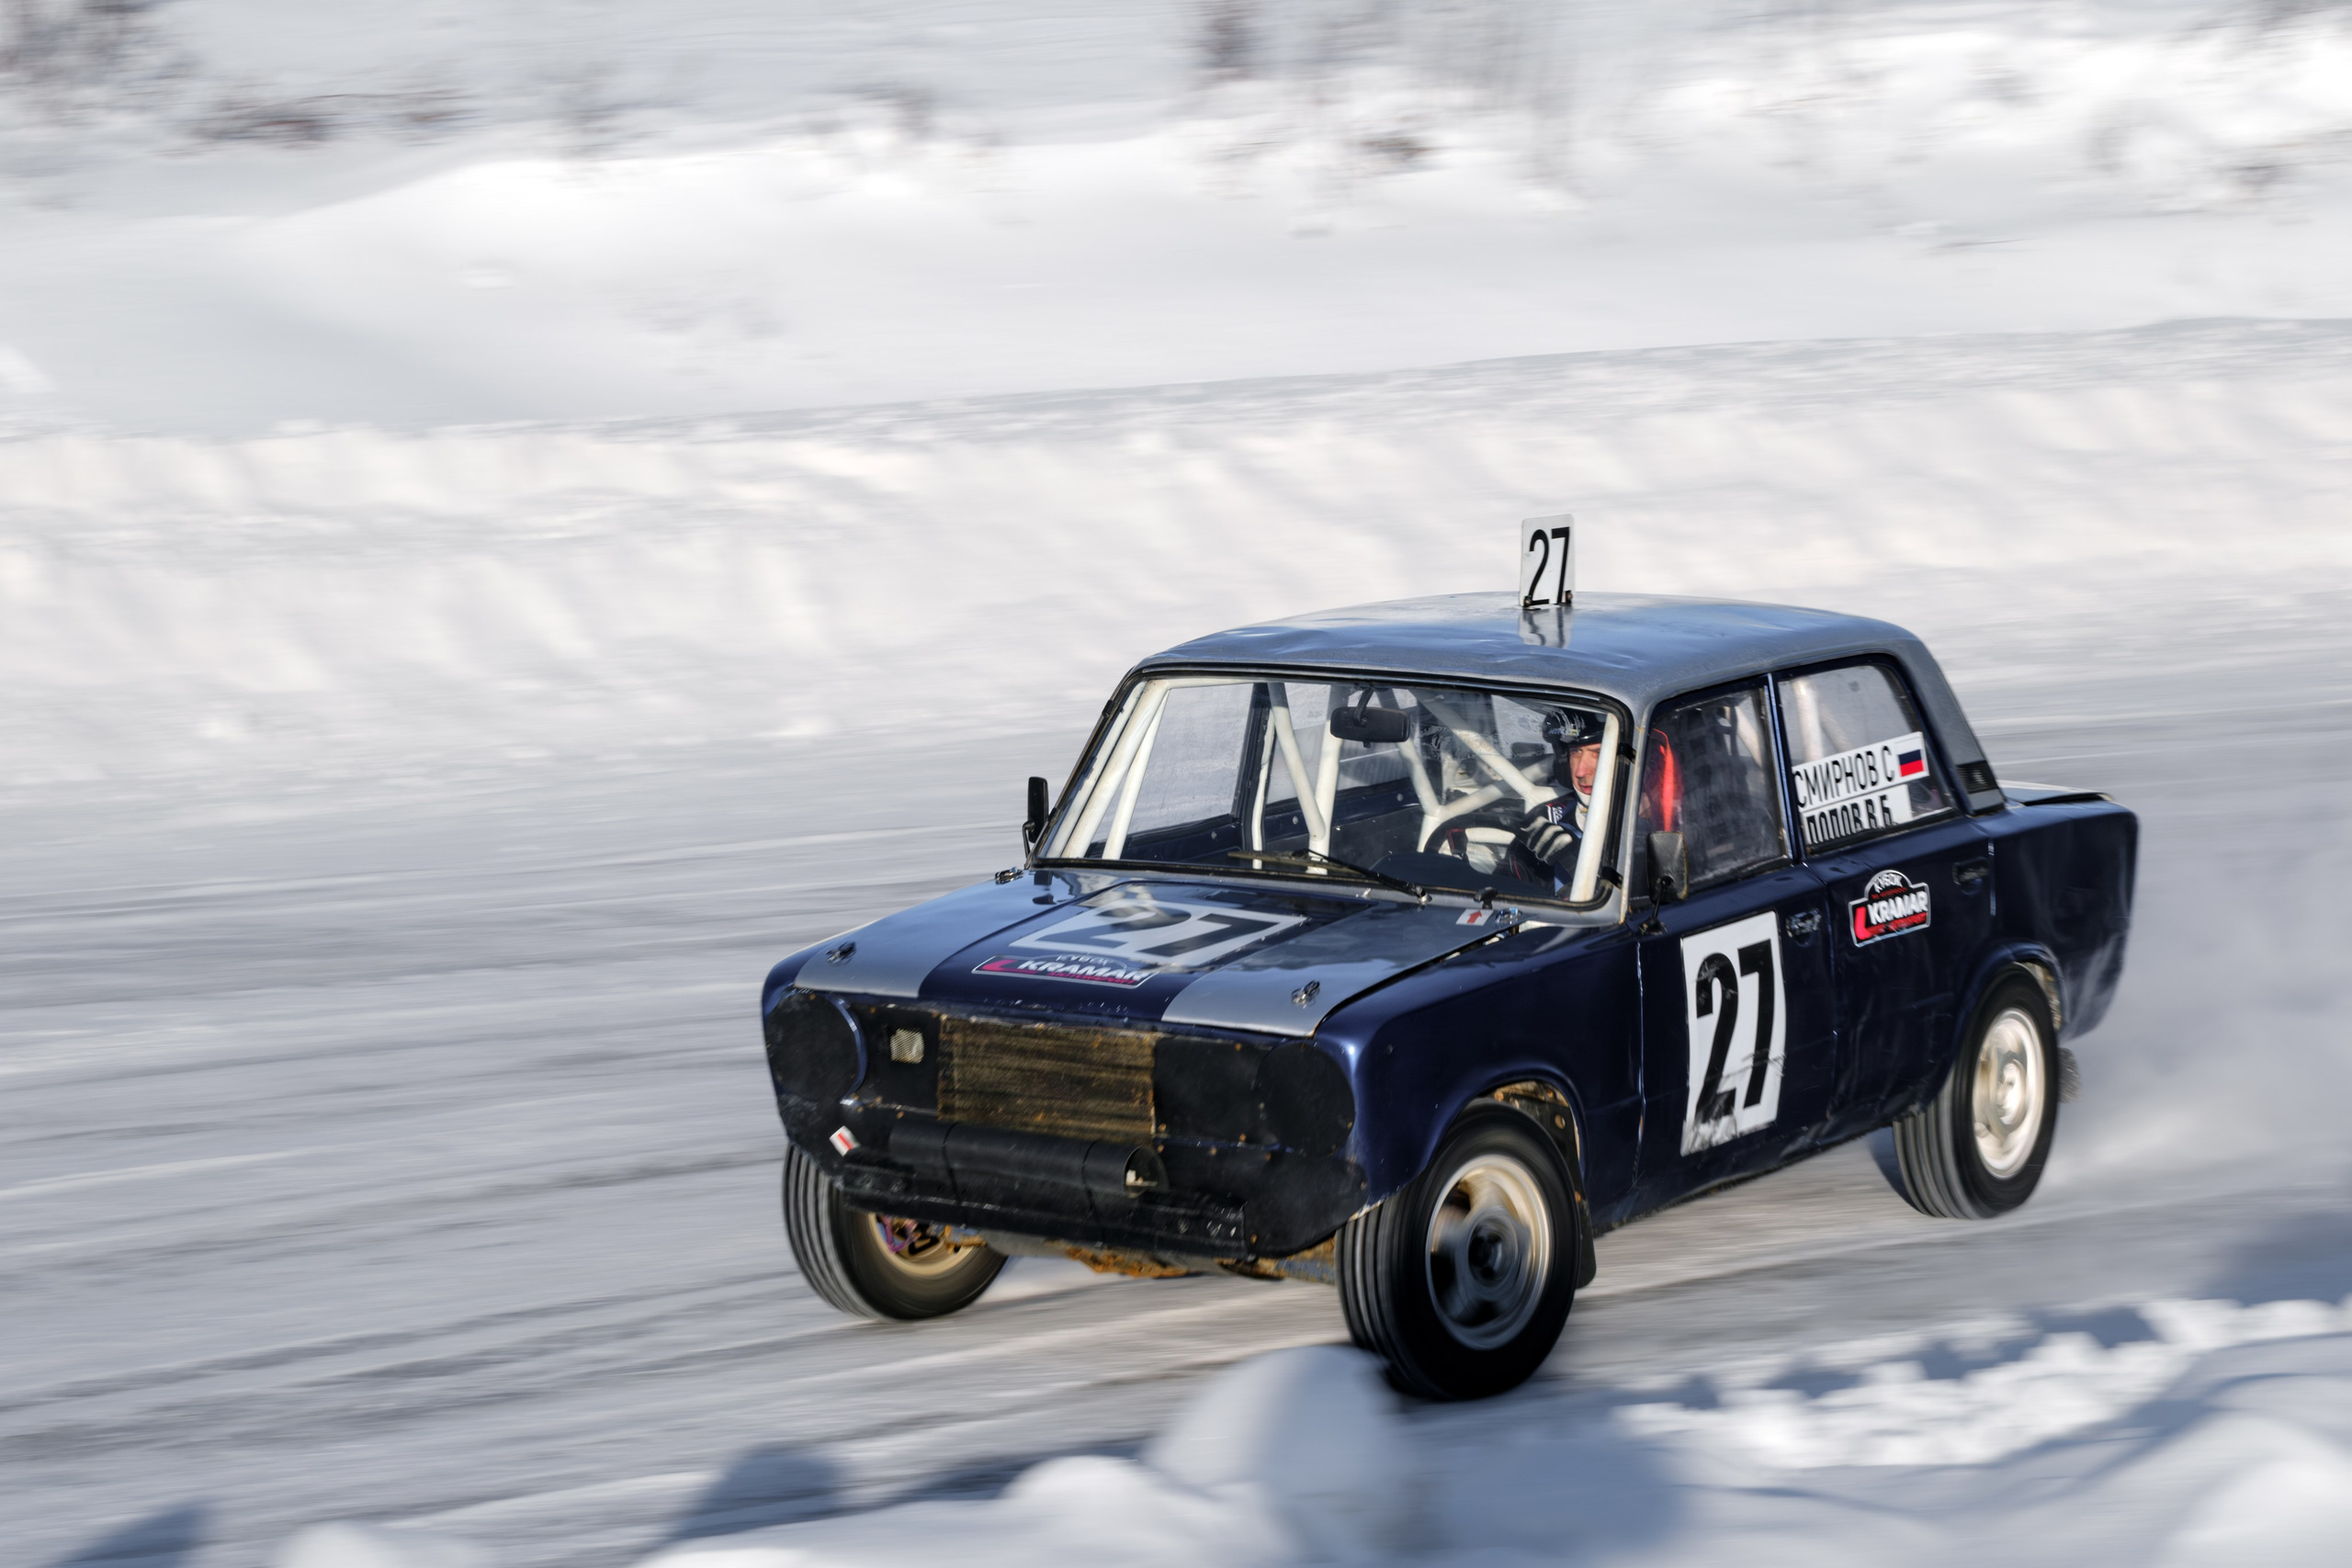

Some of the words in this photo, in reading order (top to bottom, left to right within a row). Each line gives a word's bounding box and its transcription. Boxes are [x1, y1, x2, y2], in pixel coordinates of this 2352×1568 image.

[1529, 526, 1570, 605] 27
[1793, 750, 1879, 808] СМИРНОВ
[1882, 745, 1894, 782] С
[1034, 906, 1281, 957] 27
[1868, 891, 1928, 925] KRAMAR
[1017, 960, 1148, 982] KRAMAR
[1695, 939, 1775, 1123] 27
